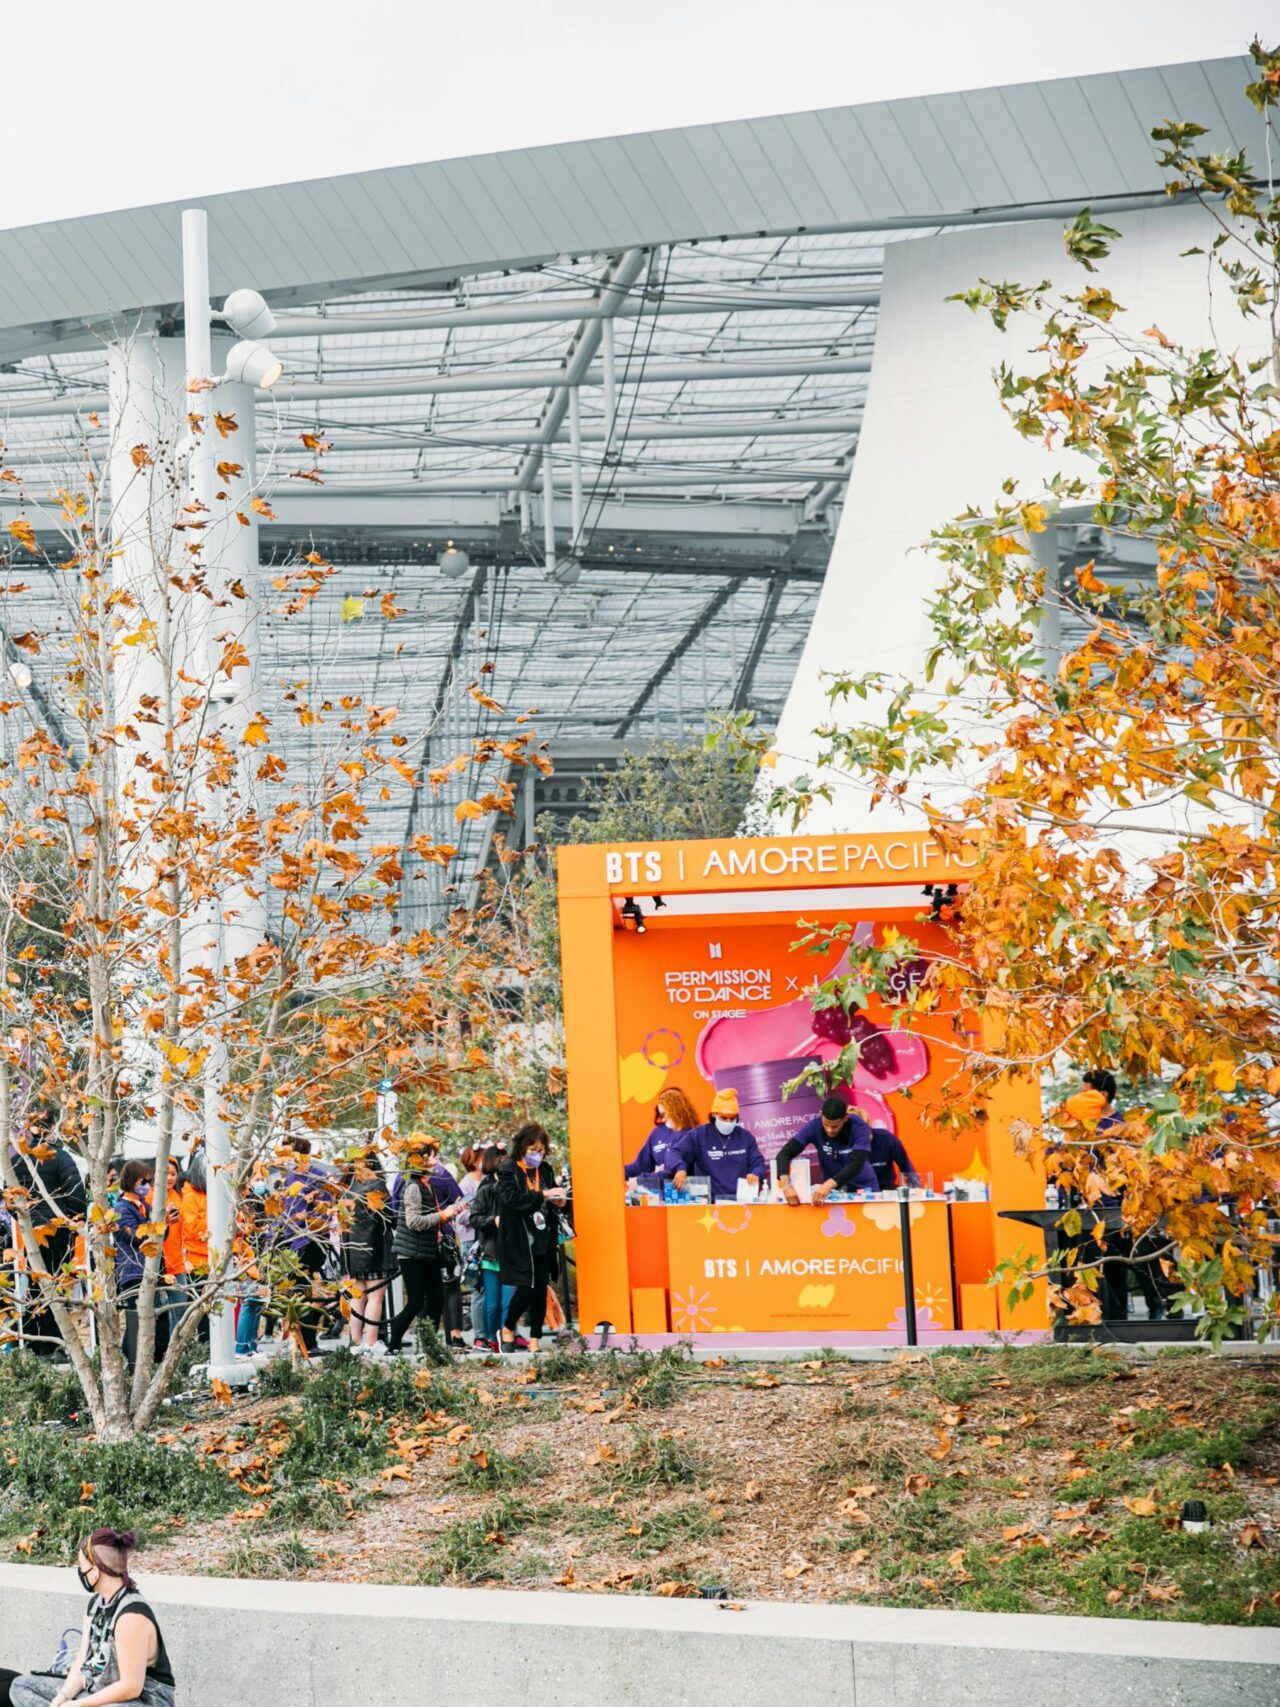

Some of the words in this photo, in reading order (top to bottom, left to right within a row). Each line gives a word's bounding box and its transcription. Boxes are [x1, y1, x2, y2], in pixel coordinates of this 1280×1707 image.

[607, 851, 662, 884] BTS
[703, 840, 978, 877] AMOREPACIFIC
[665, 968, 771, 986] PERMISSION
[666, 988, 690, 1003] TO
[694, 986, 772, 1002] DANCE
[693, 1010, 709, 1019] ON
[711, 1009, 747, 1018] STAGE
[704, 1259, 737, 1278] BTS
[759, 1258, 904, 1275] AMOREPACIFI
